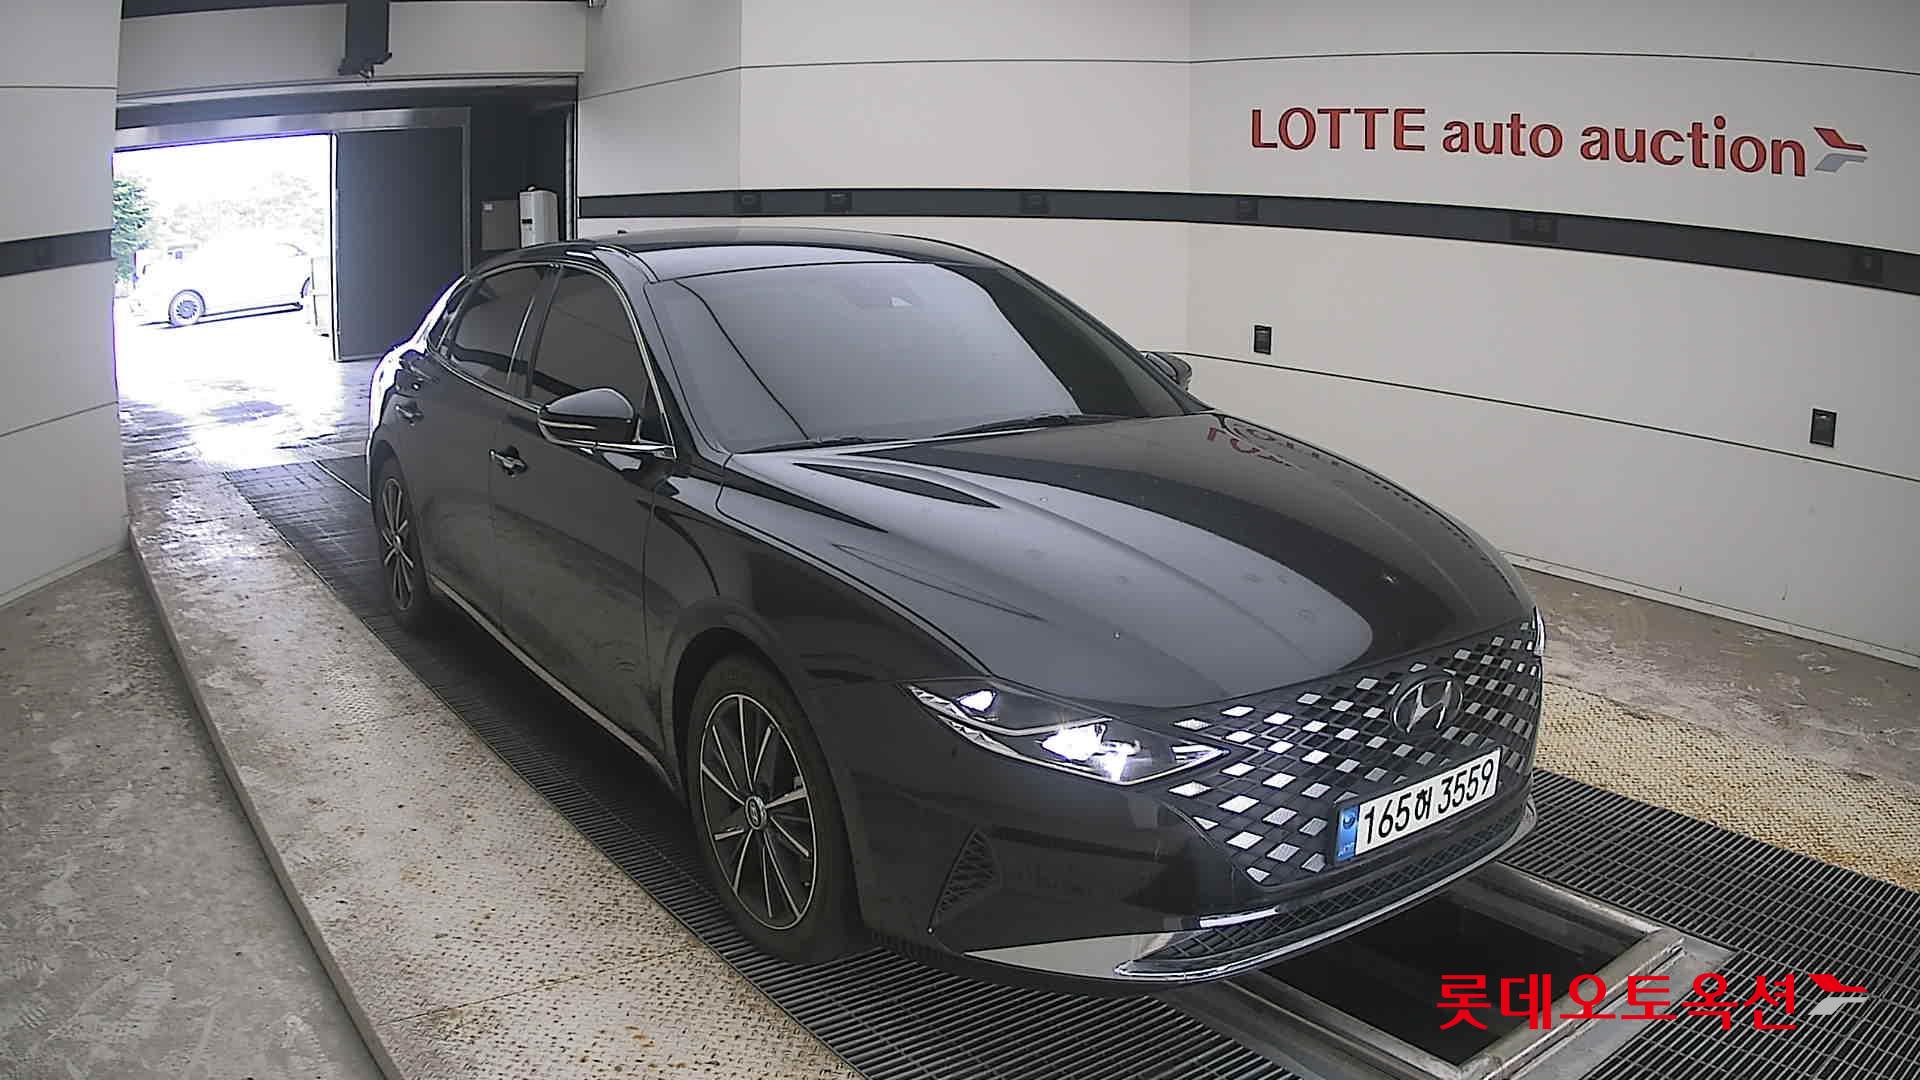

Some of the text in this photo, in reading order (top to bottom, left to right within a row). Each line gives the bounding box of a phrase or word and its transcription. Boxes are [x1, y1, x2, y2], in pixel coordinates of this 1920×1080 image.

[1251, 107, 1807, 177] LOTTE auto auction
[1437, 758, 1495, 815] 3559
